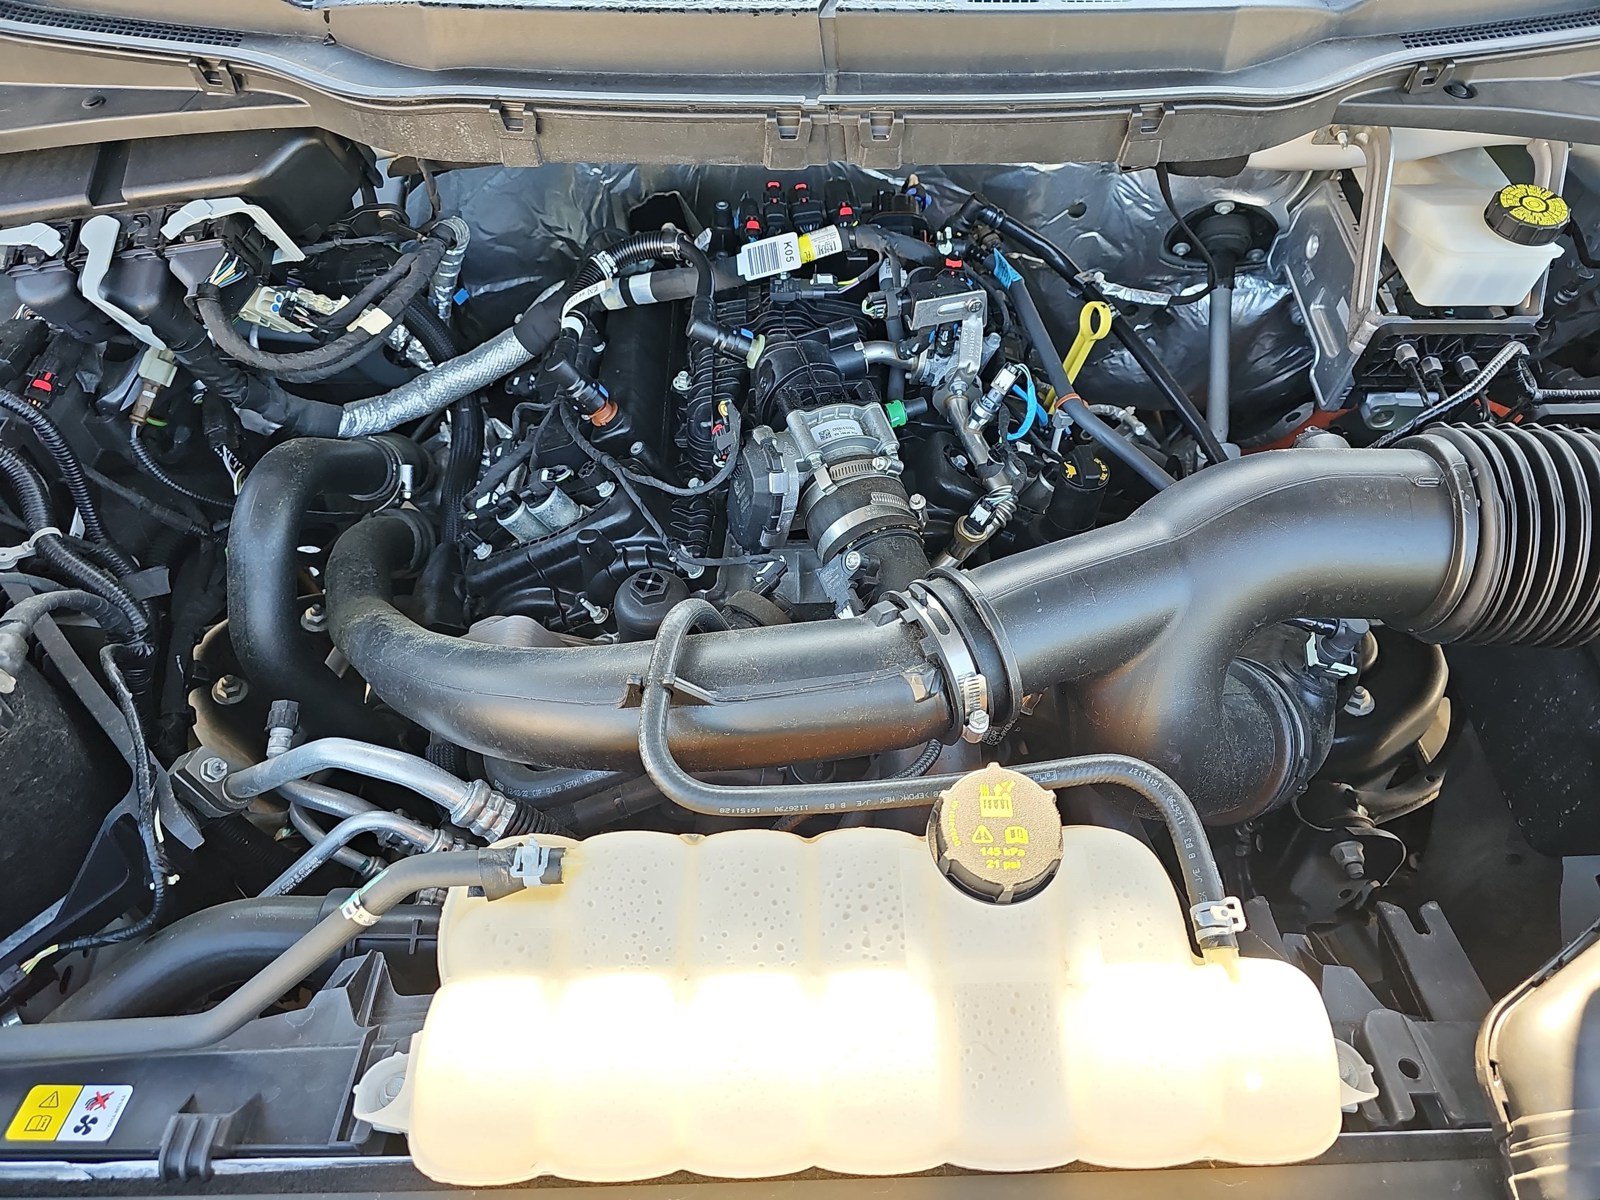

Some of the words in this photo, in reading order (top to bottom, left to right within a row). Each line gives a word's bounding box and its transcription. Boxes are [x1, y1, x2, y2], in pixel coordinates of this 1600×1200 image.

[783, 240, 795, 263] K05
[774, 804, 809, 813] 1126790
[879, 797, 895, 805] MEX
[1166, 795, 1186, 825] 1126790
